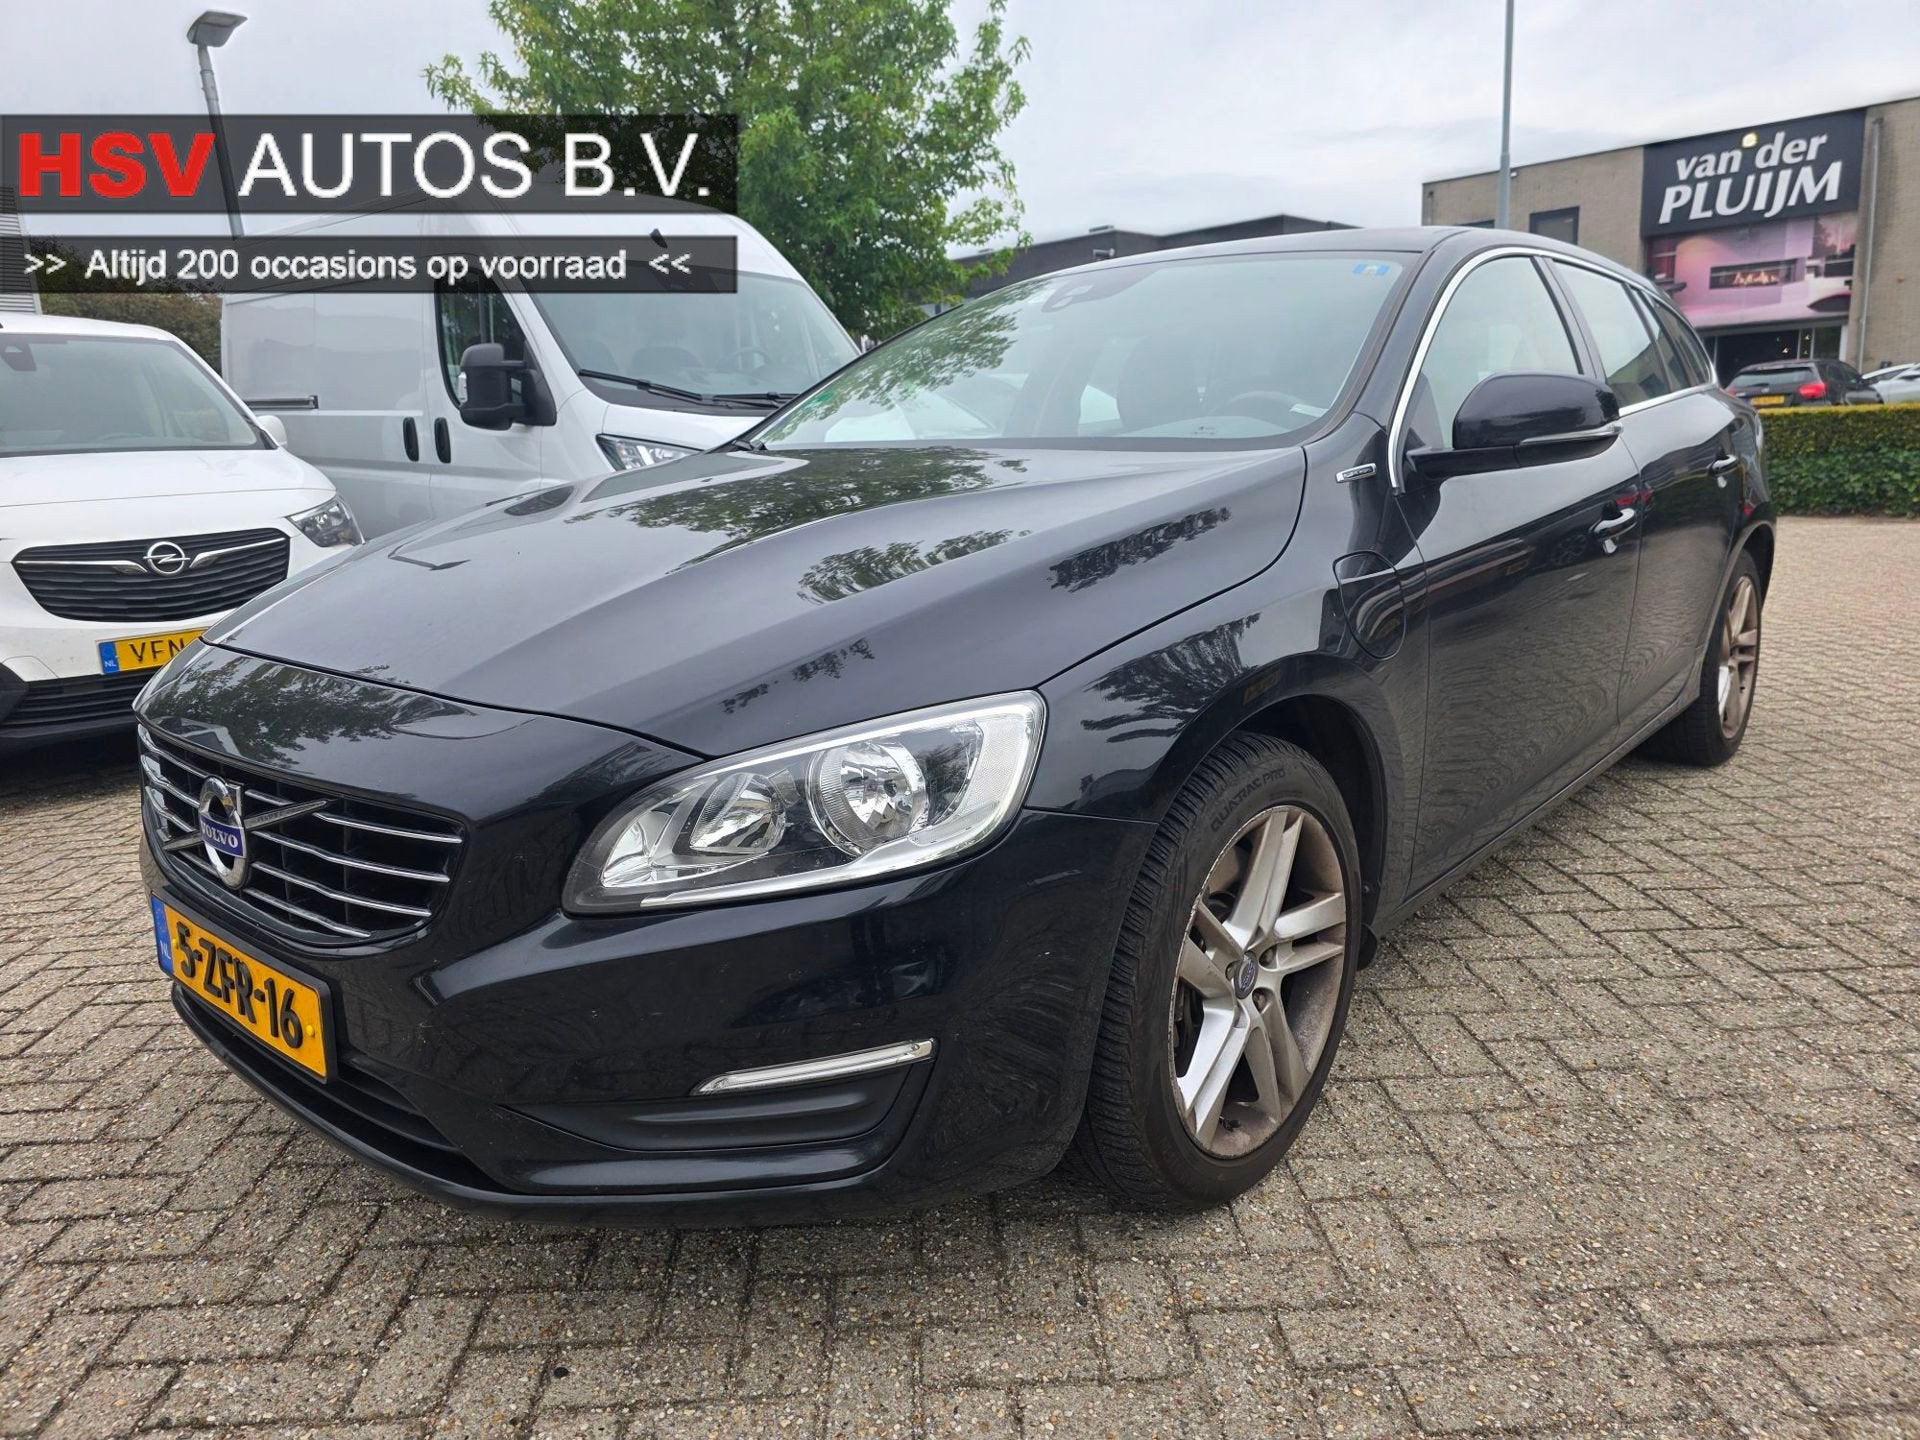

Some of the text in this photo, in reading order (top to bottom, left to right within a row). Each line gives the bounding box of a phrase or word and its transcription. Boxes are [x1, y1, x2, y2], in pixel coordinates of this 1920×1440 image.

[1676, 131, 1828, 181] van der
[1658, 161, 1842, 225] PLUIJM
[104, 660, 117, 668] NL
[1262, 767, 1286, 786] PRO
[200, 820, 239, 849] VOLVO
[159, 942, 171, 960] NL
[176, 920, 304, 1049] 5-ZFR-16
